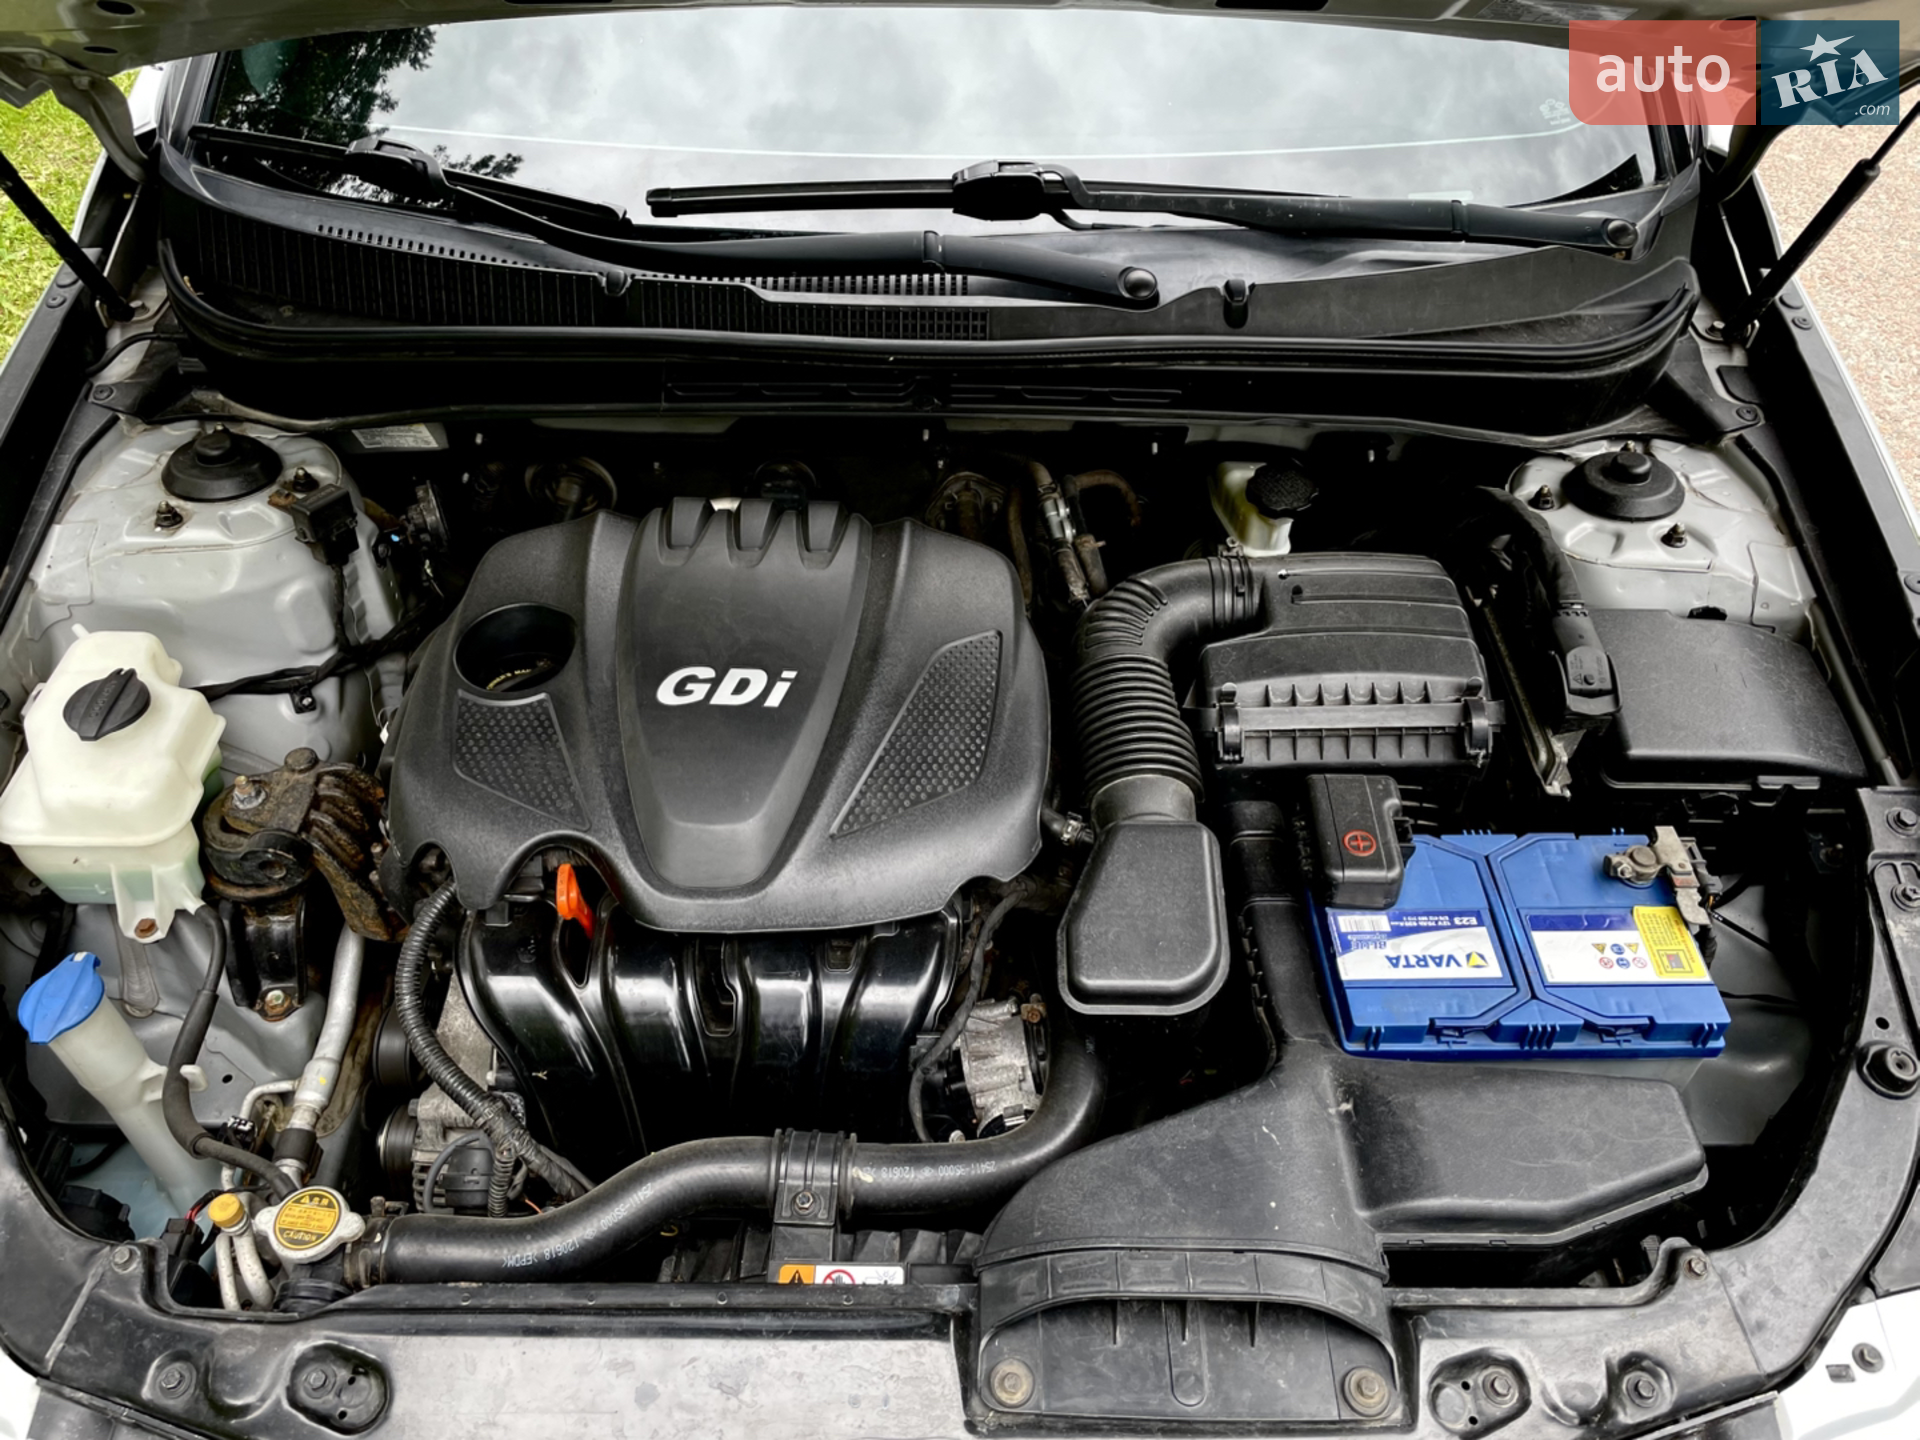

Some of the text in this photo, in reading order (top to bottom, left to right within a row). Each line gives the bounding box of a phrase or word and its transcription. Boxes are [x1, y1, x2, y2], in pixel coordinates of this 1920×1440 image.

[656, 666, 798, 708] GDi
[1453, 916, 1478, 926] E23
[1384, 954, 1462, 969] VARTA
